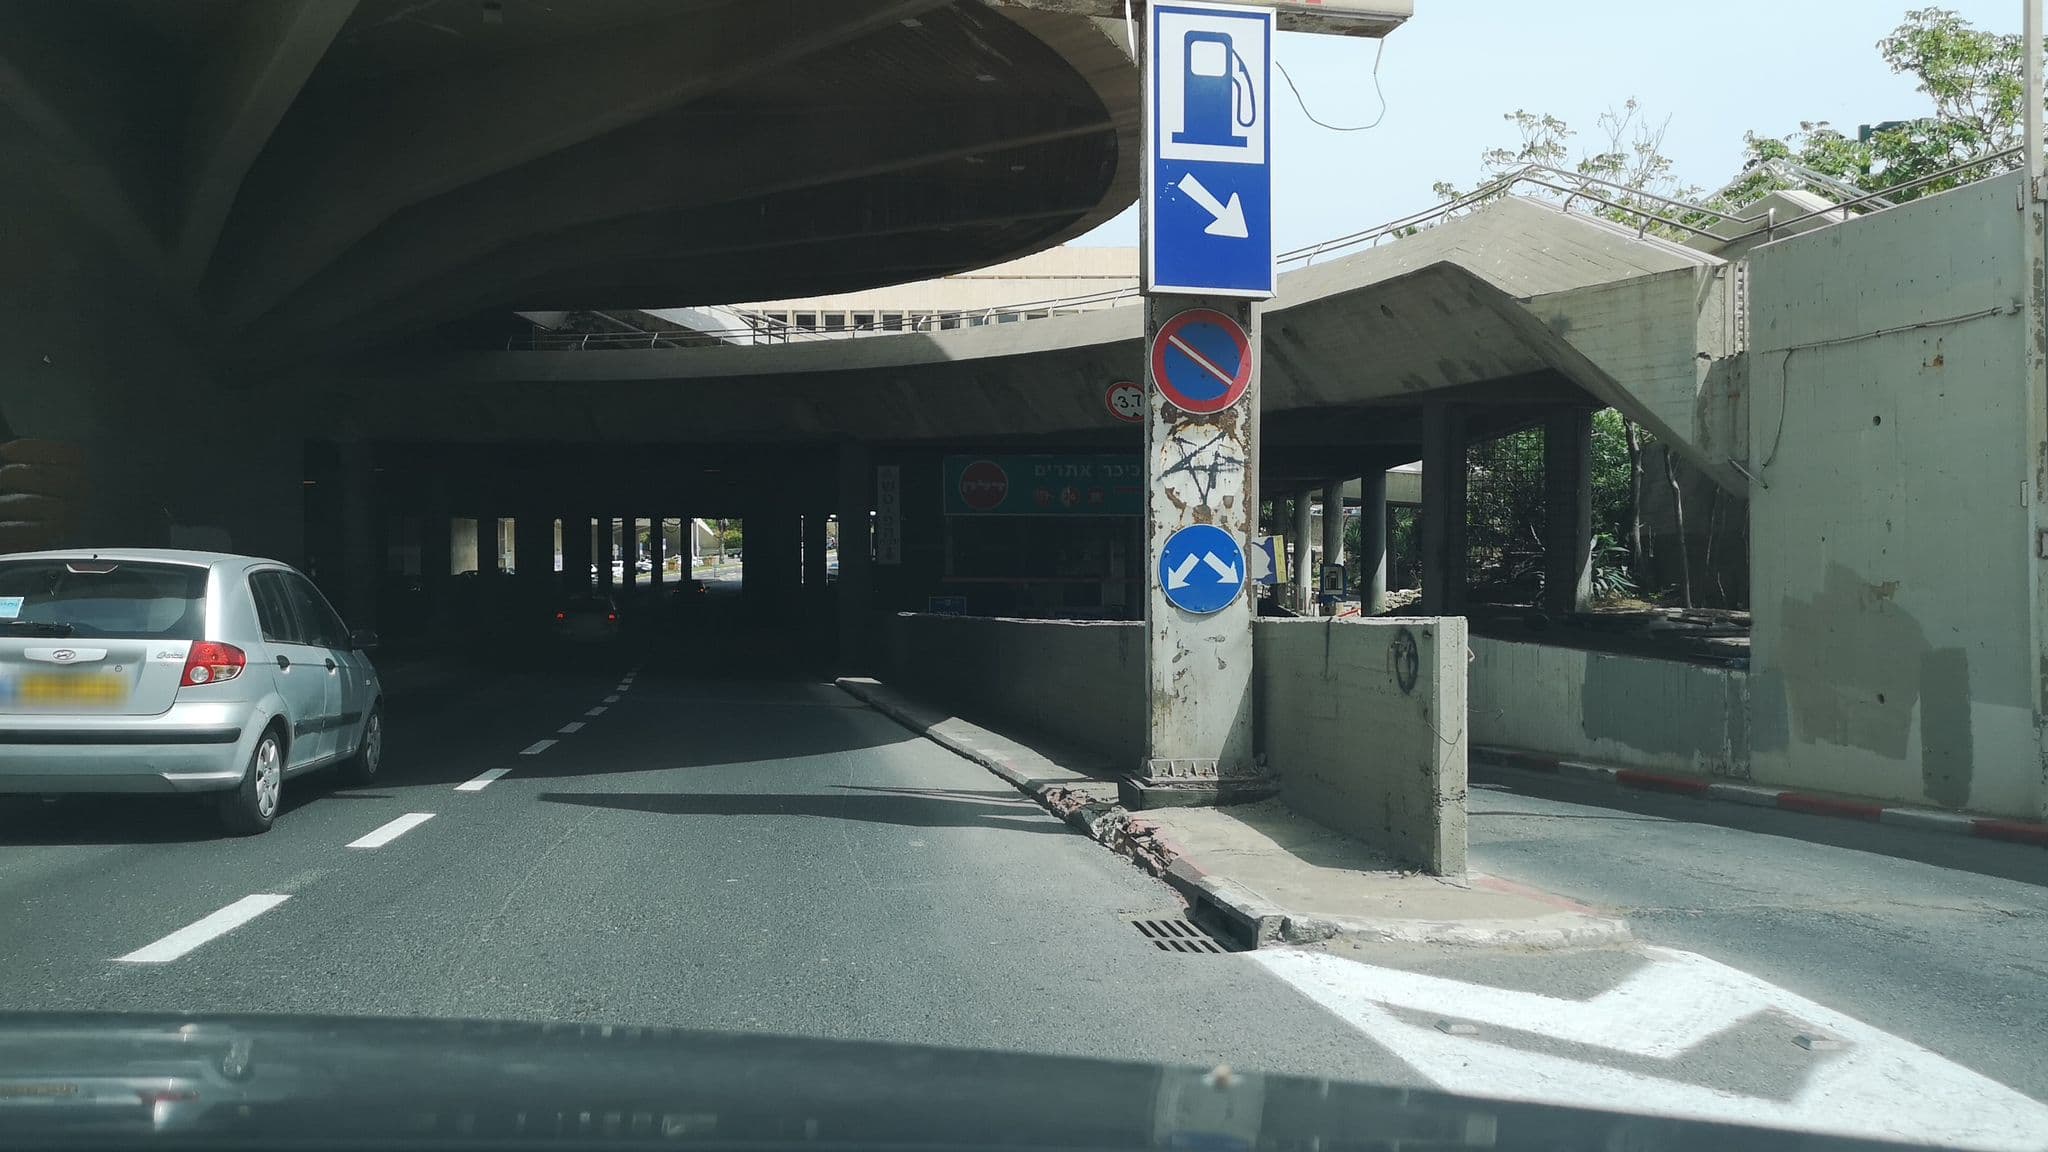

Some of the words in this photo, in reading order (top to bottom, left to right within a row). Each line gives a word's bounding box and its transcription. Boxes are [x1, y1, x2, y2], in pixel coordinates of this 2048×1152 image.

[1117, 394, 1141, 409] 3.7
[1034, 464, 1091, 477] אתרים
[1102, 464, 1141, 477] כיכר
